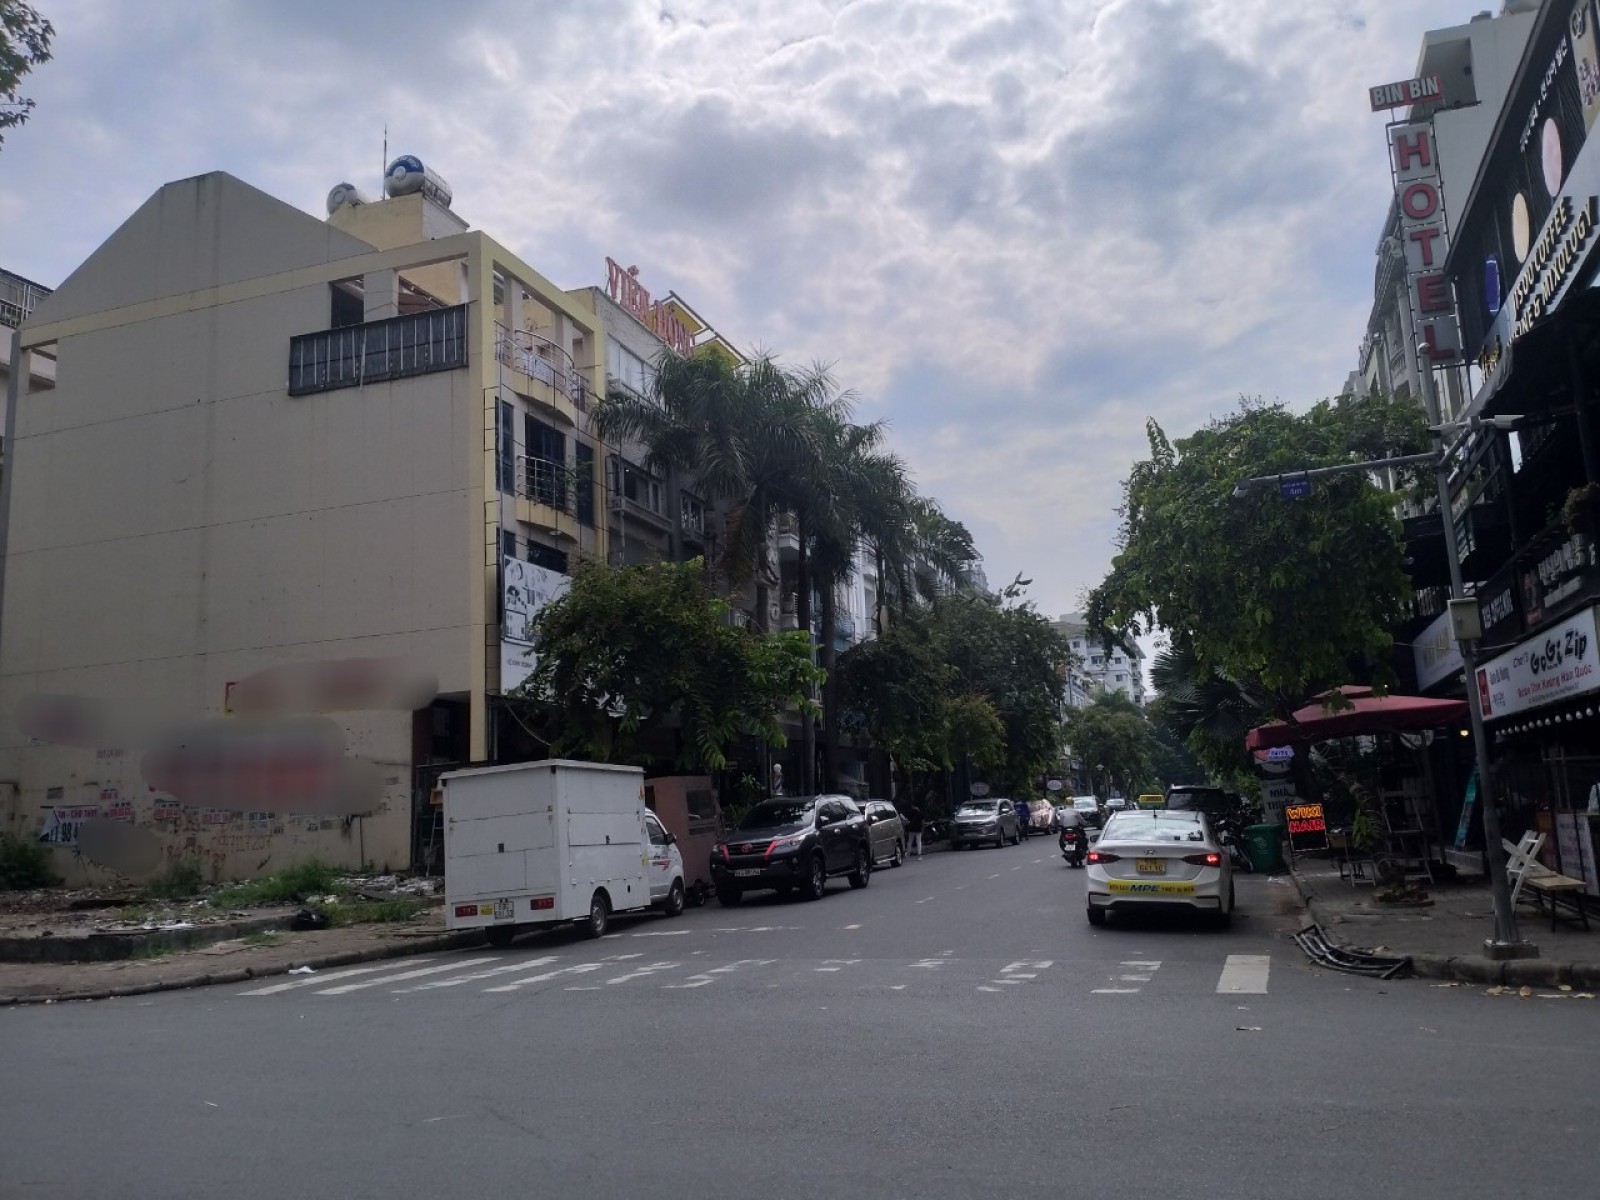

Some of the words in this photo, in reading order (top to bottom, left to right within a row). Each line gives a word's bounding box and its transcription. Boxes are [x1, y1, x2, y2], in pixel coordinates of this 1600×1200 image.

[1373, 83, 1404, 106] BIN
[1408, 76, 1439, 99] BIN
[1397, 131, 1456, 360] HOTEL
[1535, 198, 1567, 272] COFFEE
[1542, 198, 1592, 306] MIXOLOGY
[1564, 628, 1588, 661] Zip
[1288, 805, 1321, 820] WIKI
[1290, 818, 1326, 833] HAIR
[1130, 884, 1160, 892] MPE
